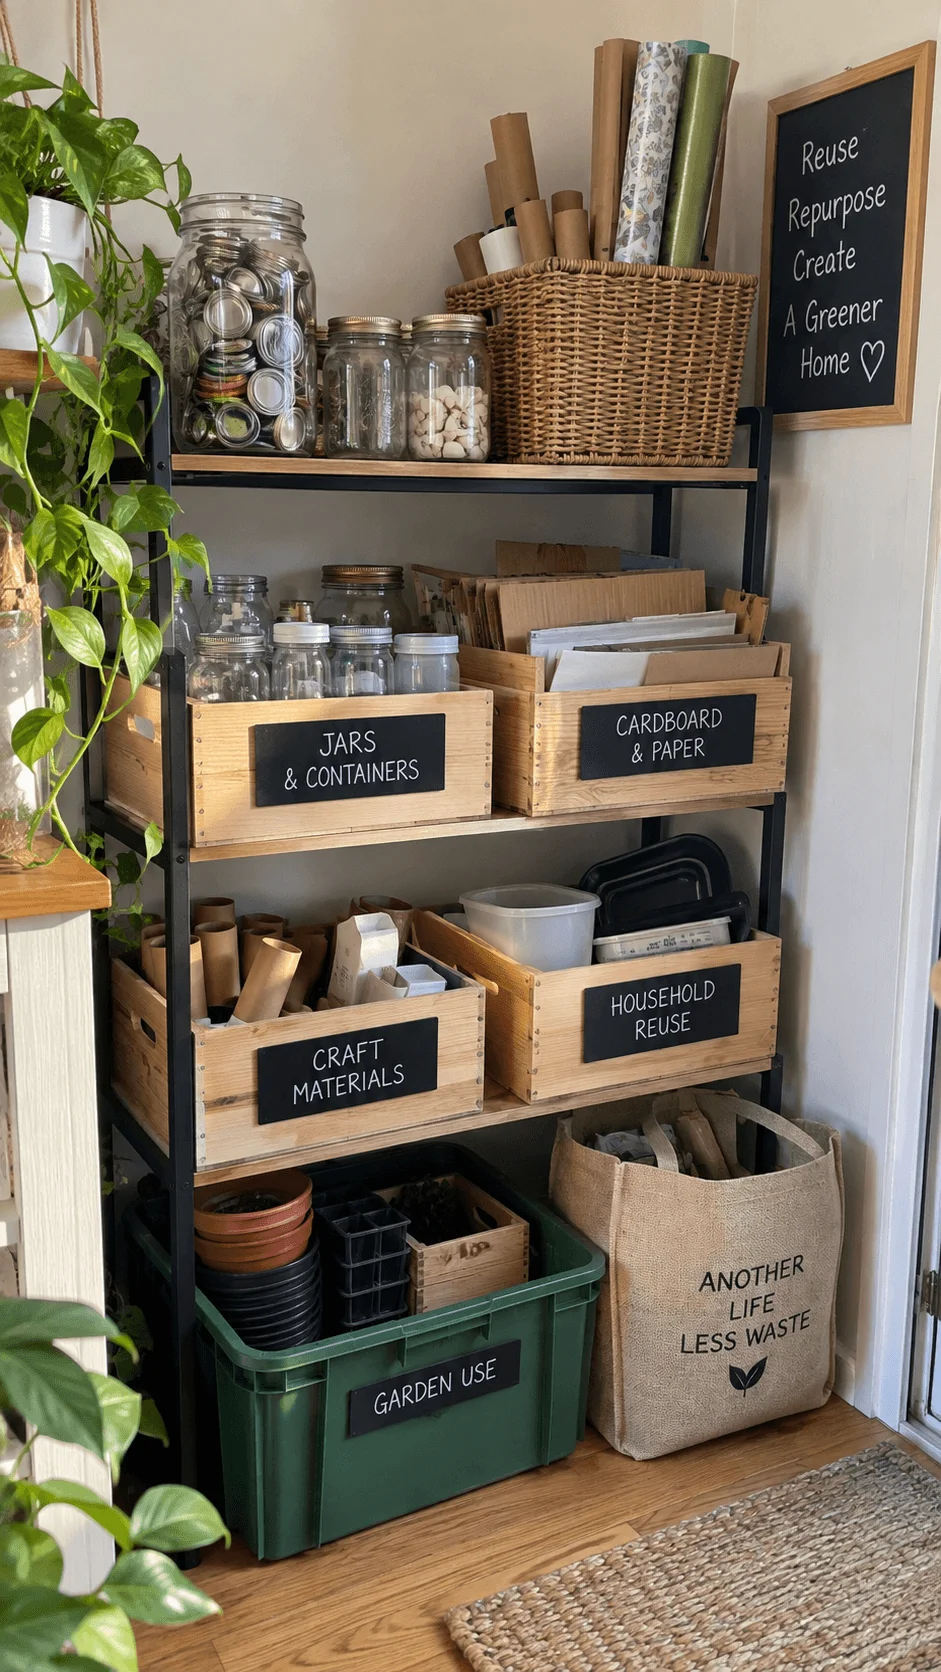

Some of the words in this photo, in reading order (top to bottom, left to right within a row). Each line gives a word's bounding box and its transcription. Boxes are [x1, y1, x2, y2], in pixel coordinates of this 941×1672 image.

[802, 135, 859, 175] Reuse
[788, 183, 886, 238] Repurpose
[793, 240, 856, 282] Create
[783, 303, 796, 337] A
[805, 298, 883, 334] Greener
[801, 346, 850, 379] Home
[616, 707, 723, 737] CARDBOARD
[319, 730, 376, 757] JARS
[631, 742, 643, 764] &
[652, 737, 706, 762] PAPER
[284, 767, 298, 791] &
[306, 758, 420, 789] CONTAINERS
[611, 979, 716, 1017] HOUSEHOLD
[635, 1011, 691, 1041] REUSE
[312, 1038, 385, 1071] CRAFT
[293, 1063, 405, 1105] MATERIALS
[698, 1254, 805, 1293] ANOTHER
[729, 1292, 776, 1321] LIFE
[680, 1330, 737, 1355] LESS
[745, 1308, 811, 1345] WASTE
[374, 1372, 452, 1415] GARDEN
[461, 1358, 497, 1387] USE
